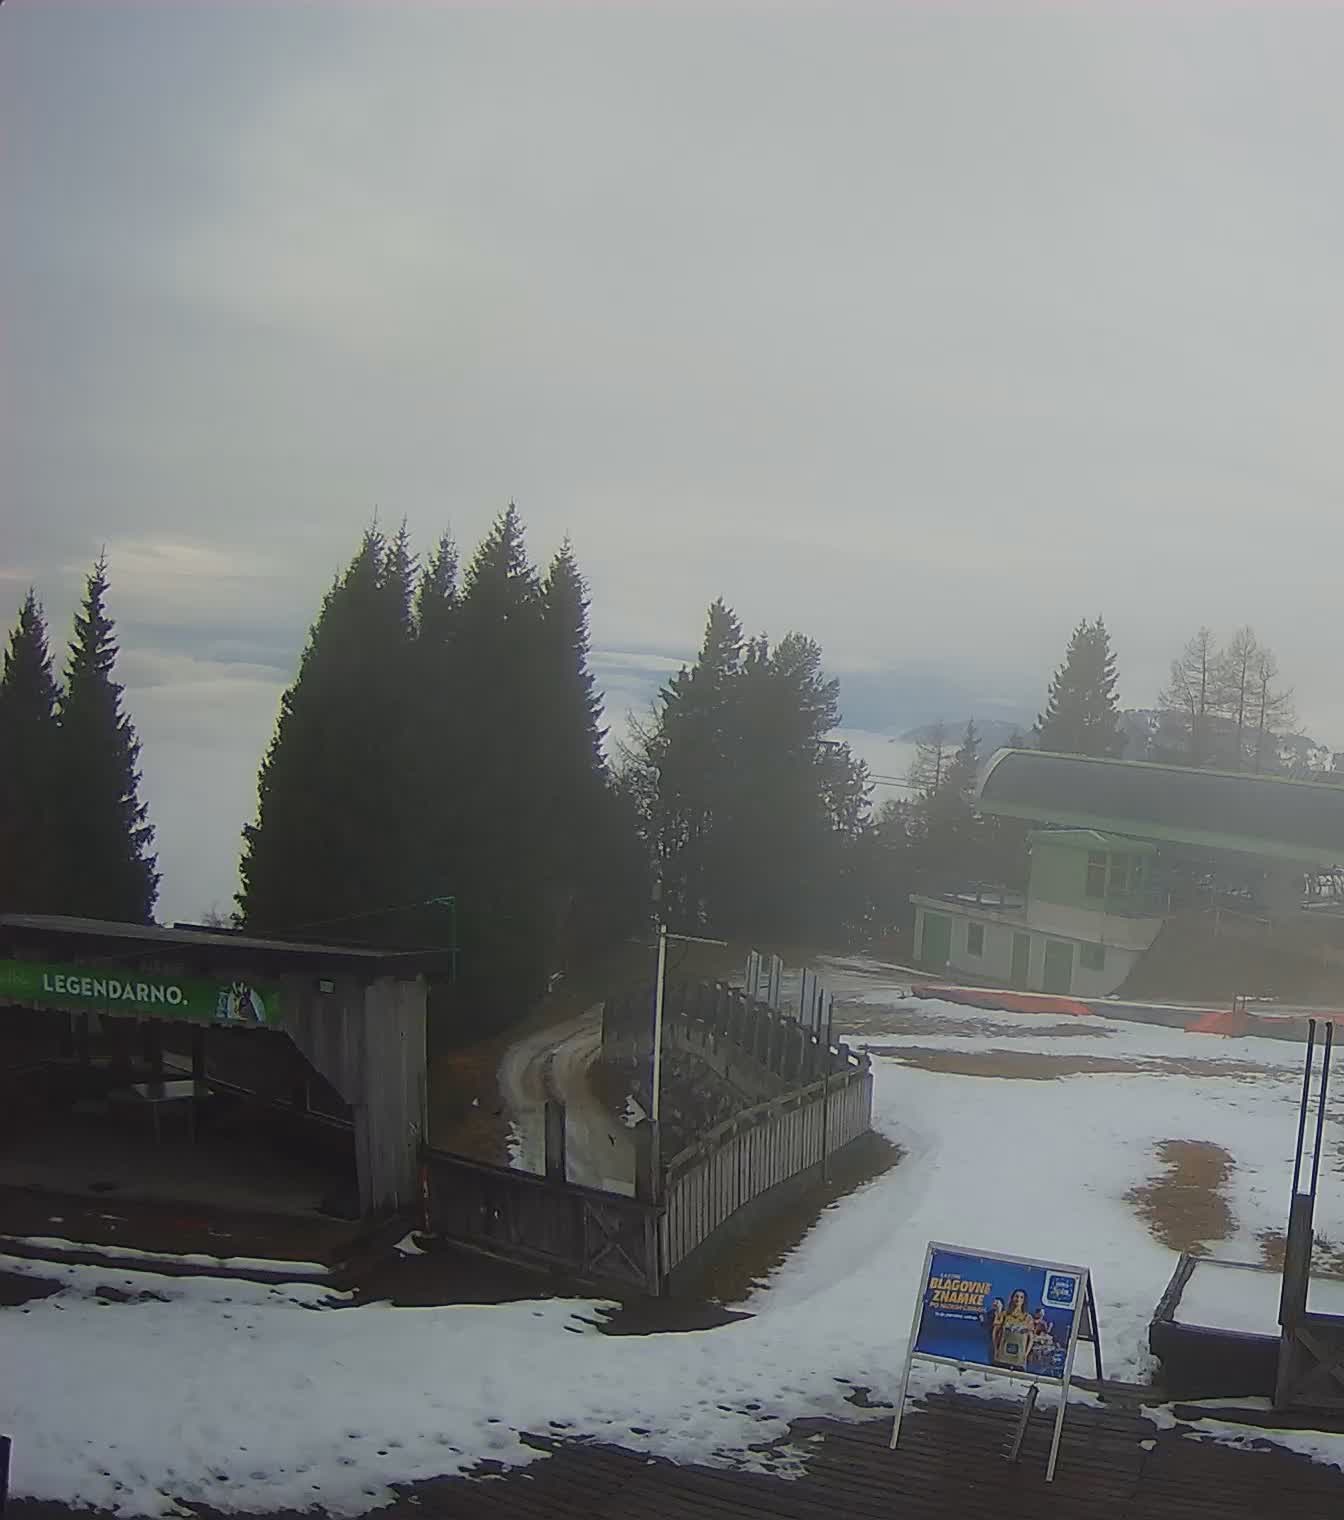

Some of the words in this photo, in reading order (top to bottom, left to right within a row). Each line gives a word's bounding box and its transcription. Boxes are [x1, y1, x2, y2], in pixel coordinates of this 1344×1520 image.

[43, 974, 189, 1006] LEGENDARNO.
[930, 1277, 992, 1295] BLAGOVNE
[932, 1290, 985, 1305] ZNAMKE
